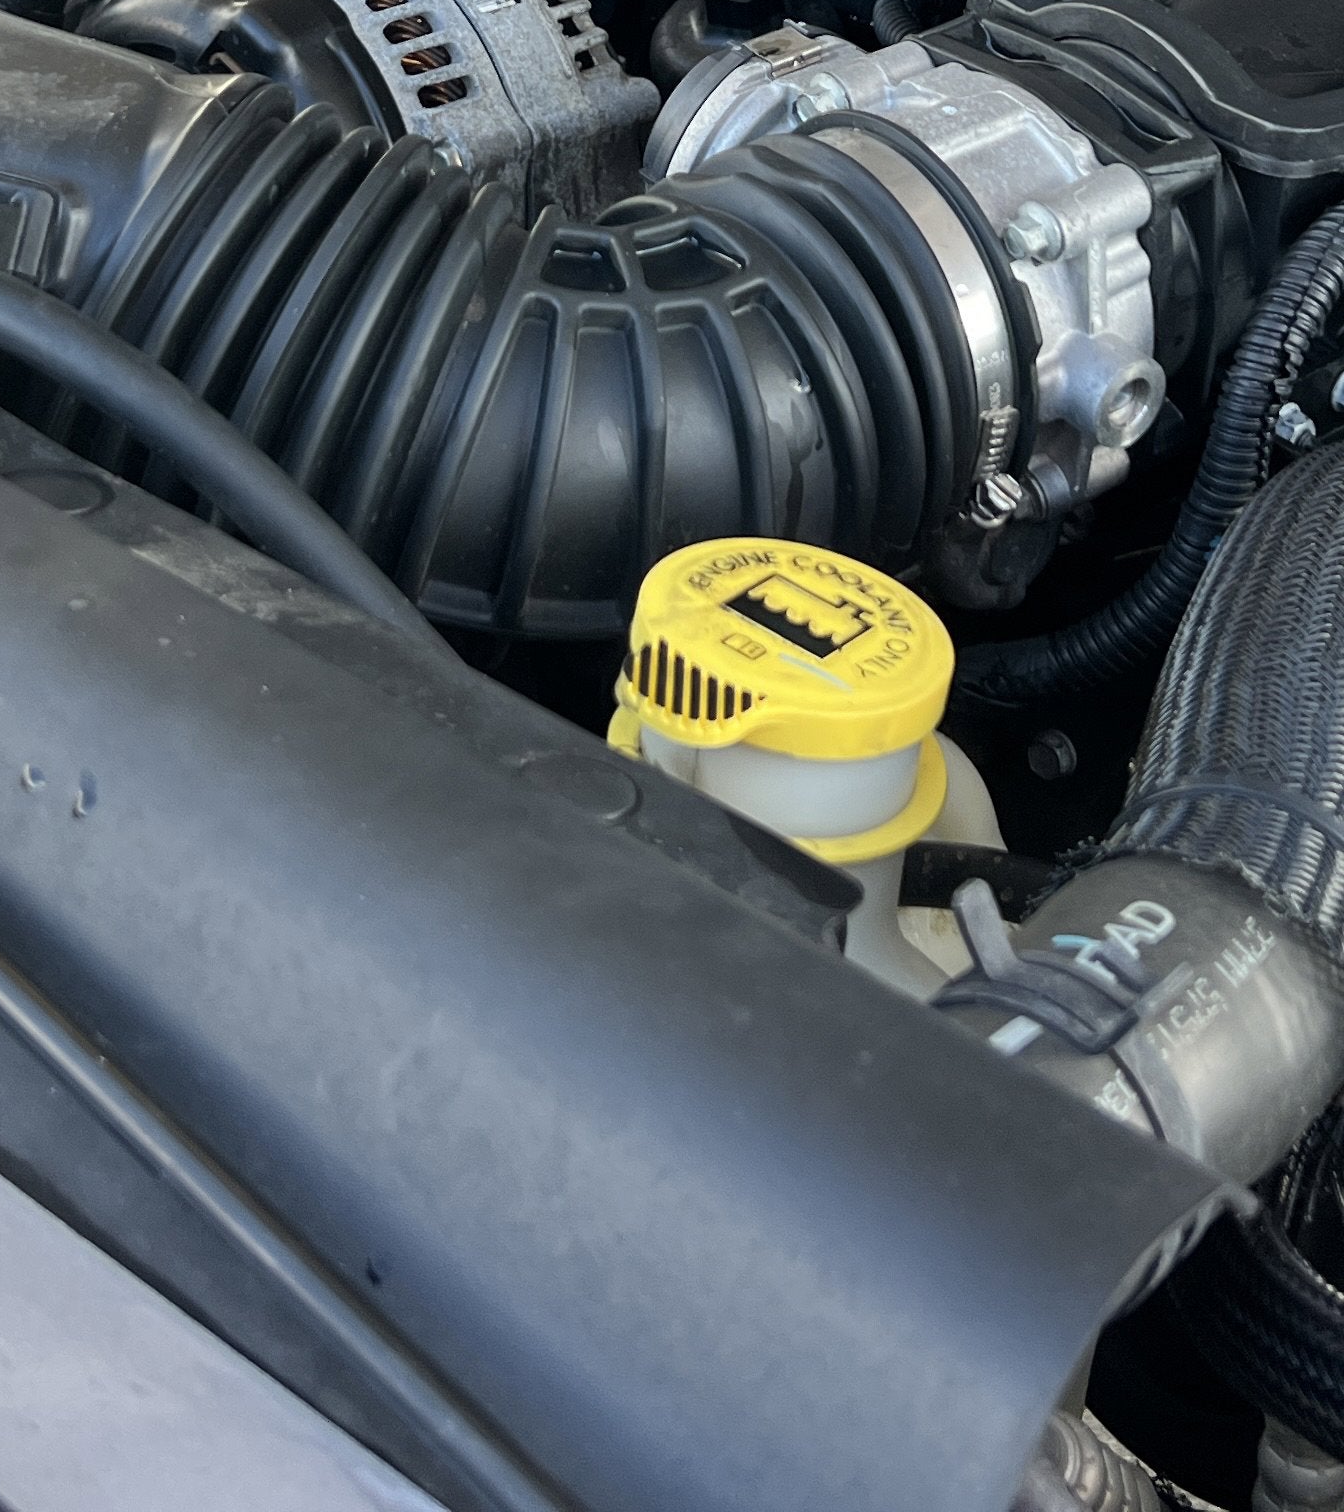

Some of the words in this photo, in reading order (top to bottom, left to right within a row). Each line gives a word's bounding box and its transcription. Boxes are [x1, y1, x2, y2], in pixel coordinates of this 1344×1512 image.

[688, 550, 778, 590] ENGINE
[792, 554, 914, 637] COOLANT
[855, 638, 911, 678] ONLY
